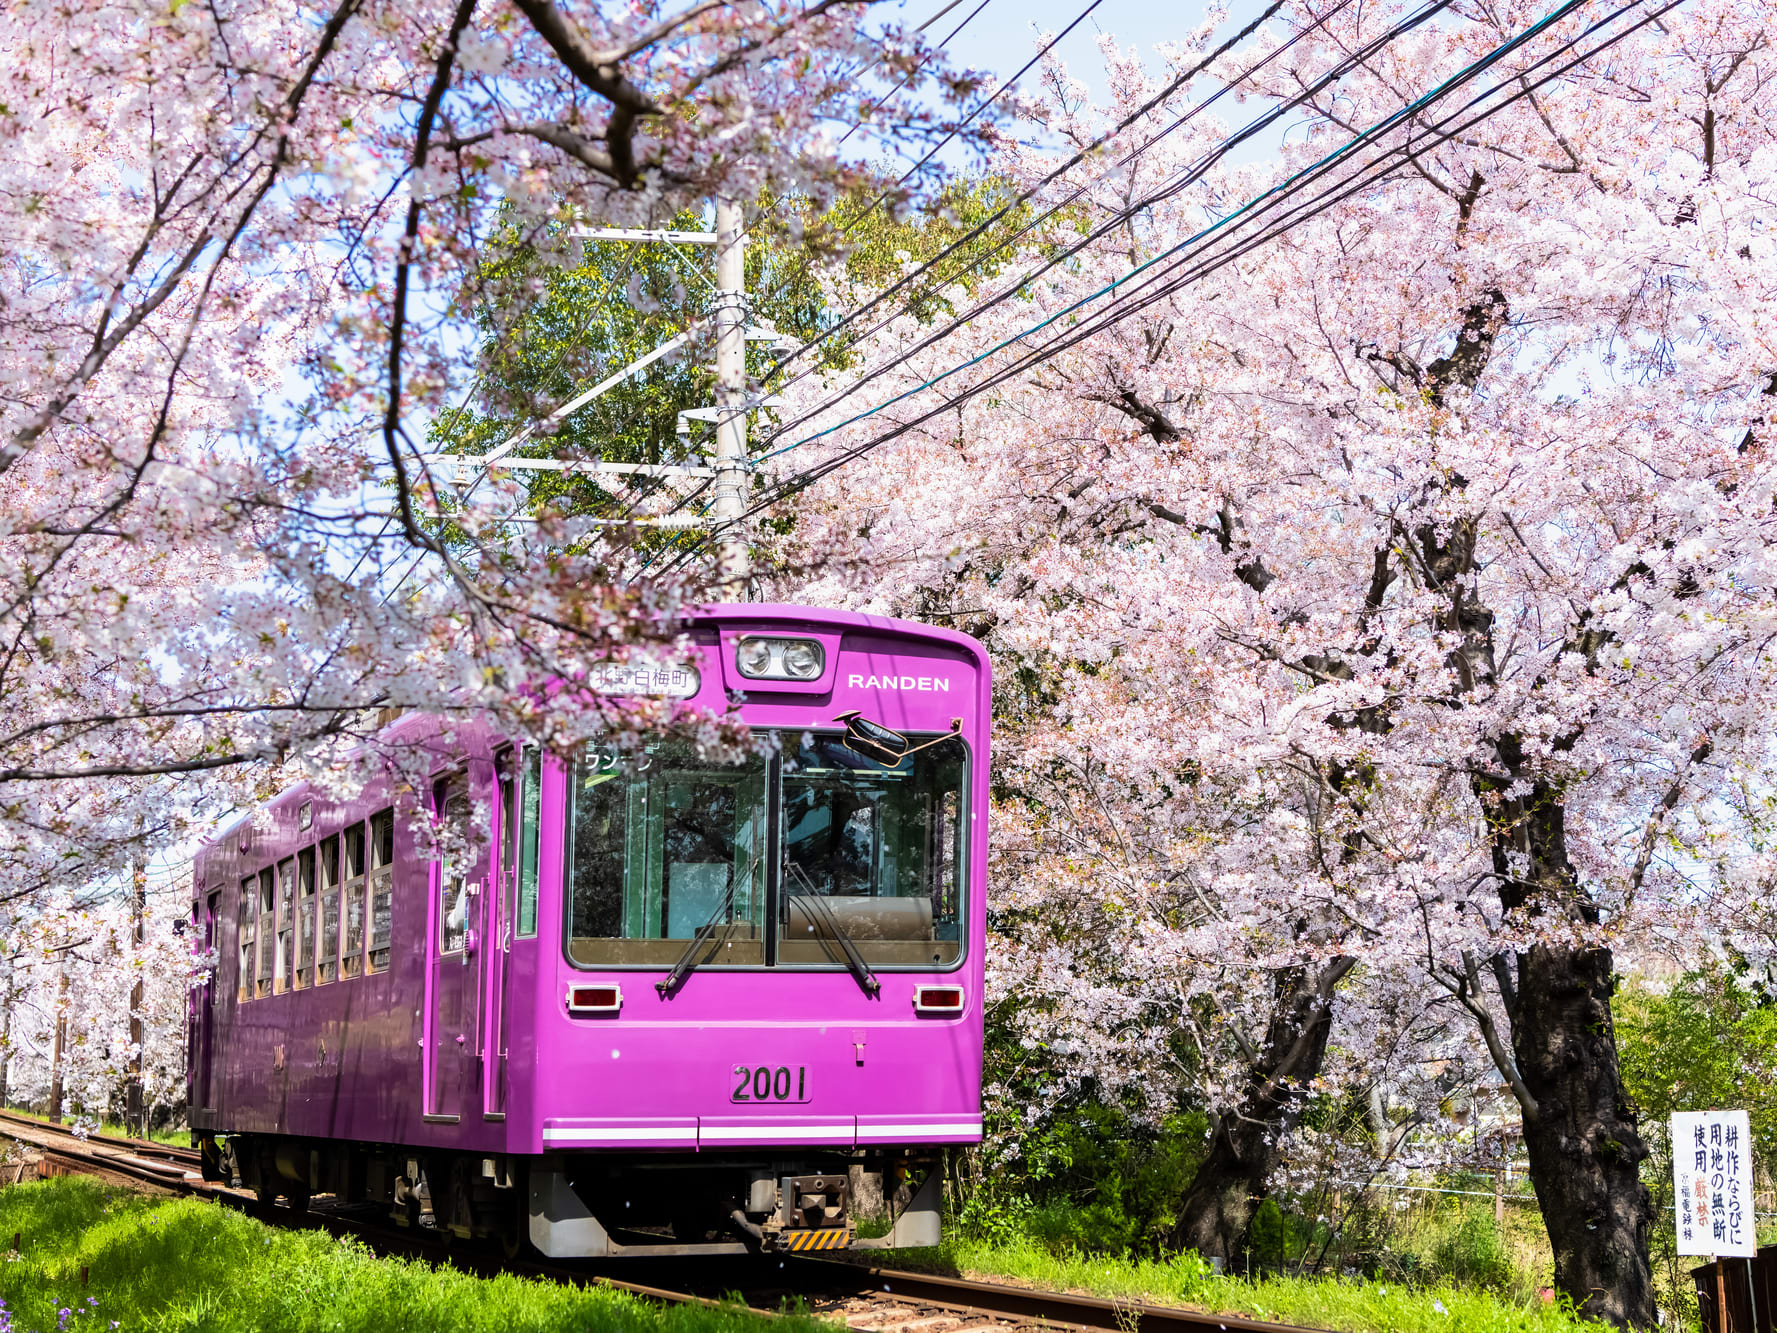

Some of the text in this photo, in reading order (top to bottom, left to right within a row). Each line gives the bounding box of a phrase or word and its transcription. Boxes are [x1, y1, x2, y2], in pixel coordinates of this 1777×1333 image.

[848, 674, 949, 692] RANDEN
[585, 754, 653, 771] ワンン
[733, 1066, 805, 1101] 2001
[1694, 1124, 1708, 1227] 使用厳禁
[1710, 1123, 1726, 1243] 用地の無断
[1725, 1125, 1742, 1245] 耕作ならびに
